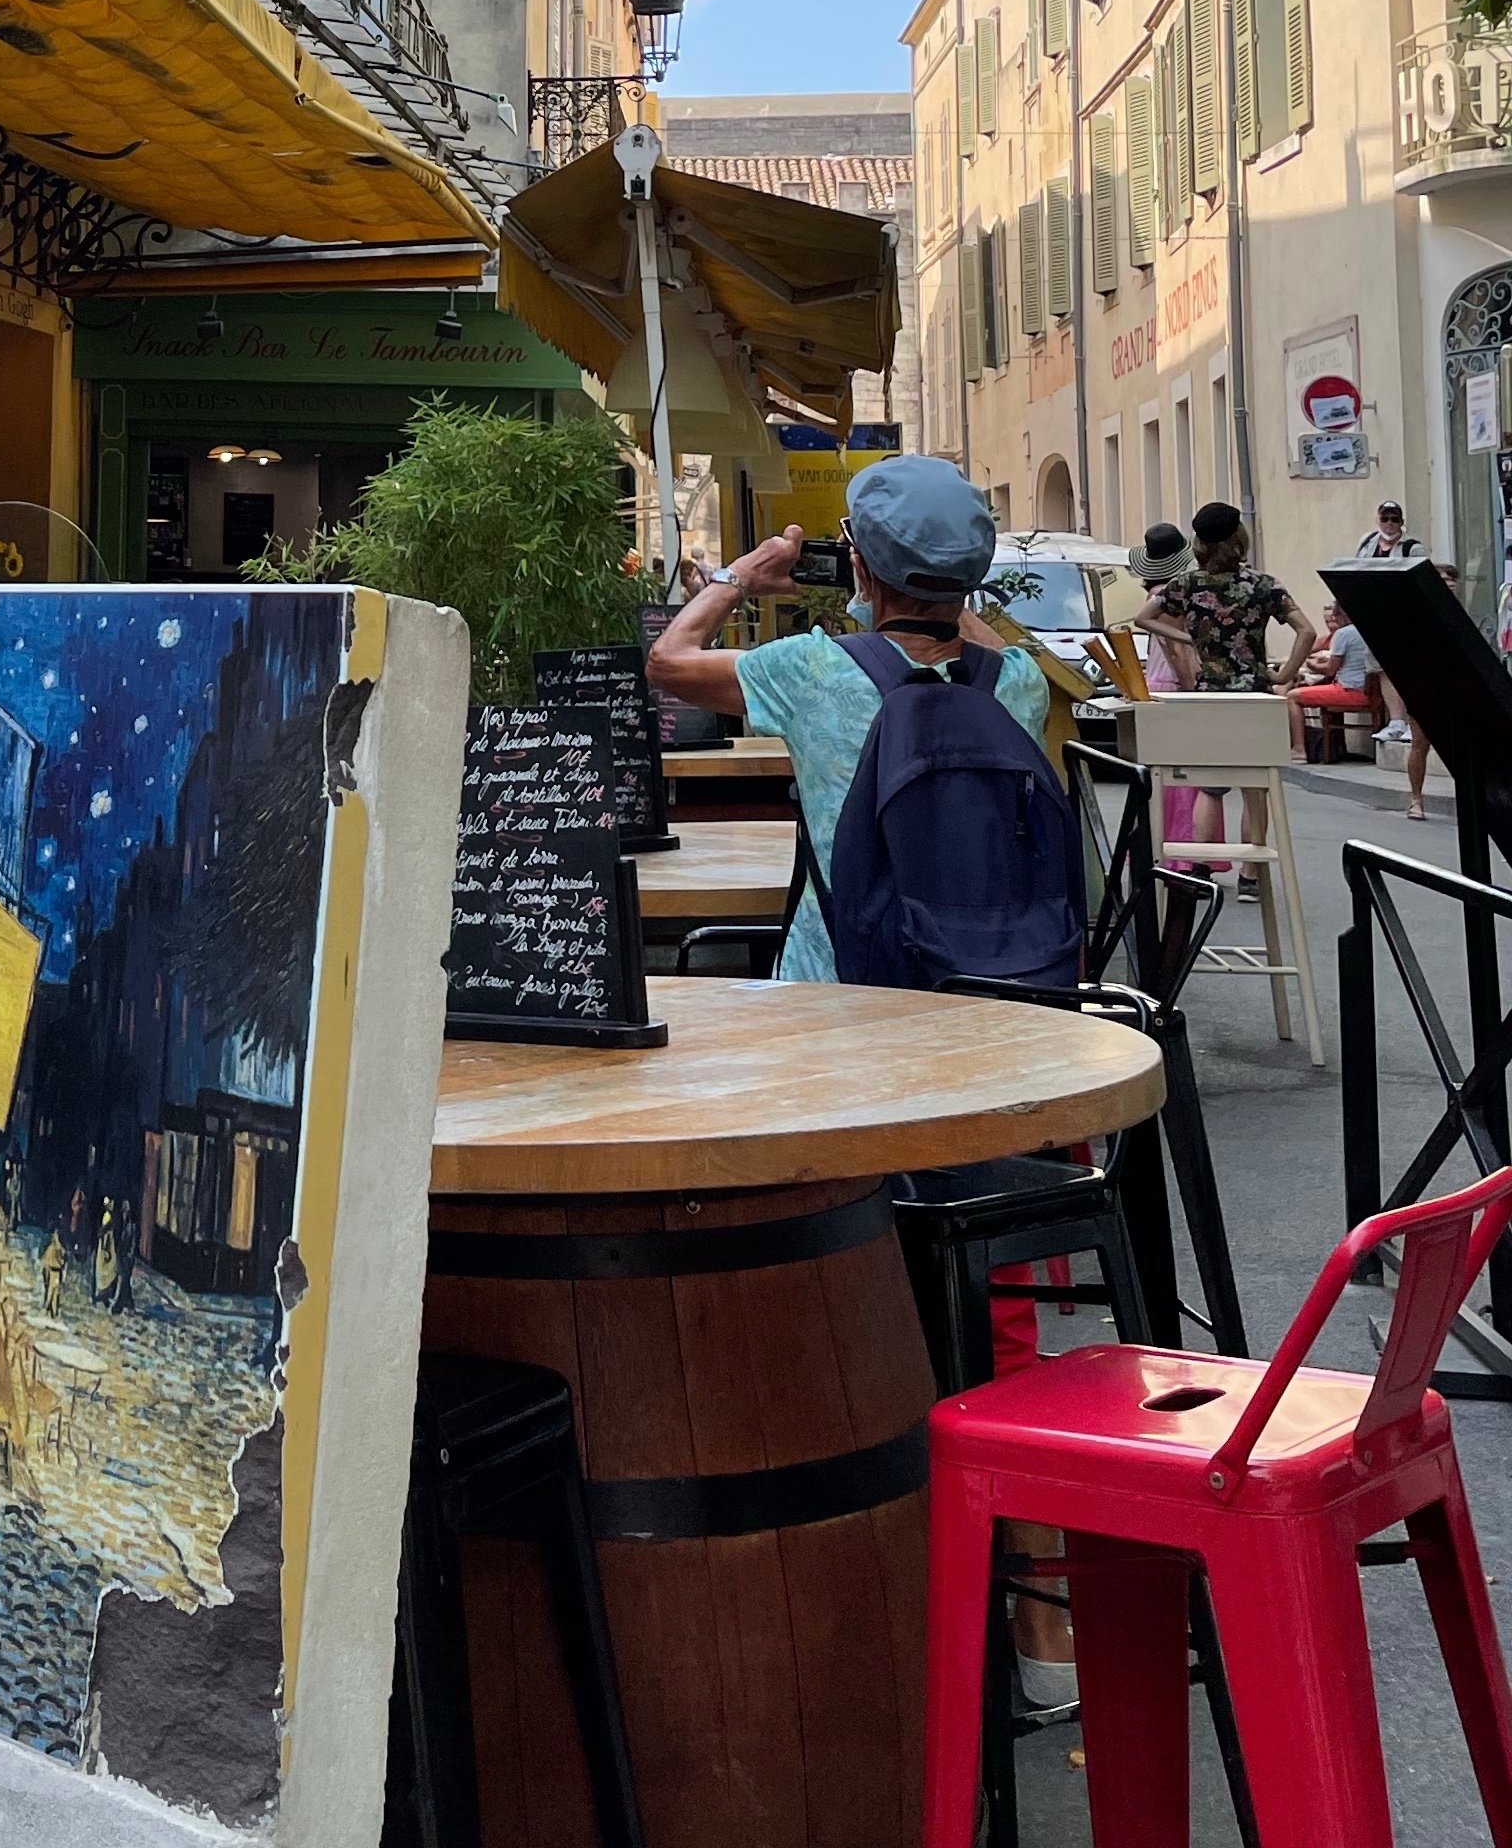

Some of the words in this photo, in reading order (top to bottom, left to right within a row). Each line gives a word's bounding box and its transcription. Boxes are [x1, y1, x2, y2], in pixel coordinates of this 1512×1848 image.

[8, 292, 35, 326] Gogh
[1112, 325, 1143, 380] GRAND
[1165, 280, 1189, 342] NORD
[1192, 255, 1218, 322] PINUS
[223, 323, 289, 359] Bar
[304, 325, 349, 361] Le
[360, 326, 528, 364] Tambourin
[479, 706, 505, 733] Nos
[543, 767, 561, 783] et
